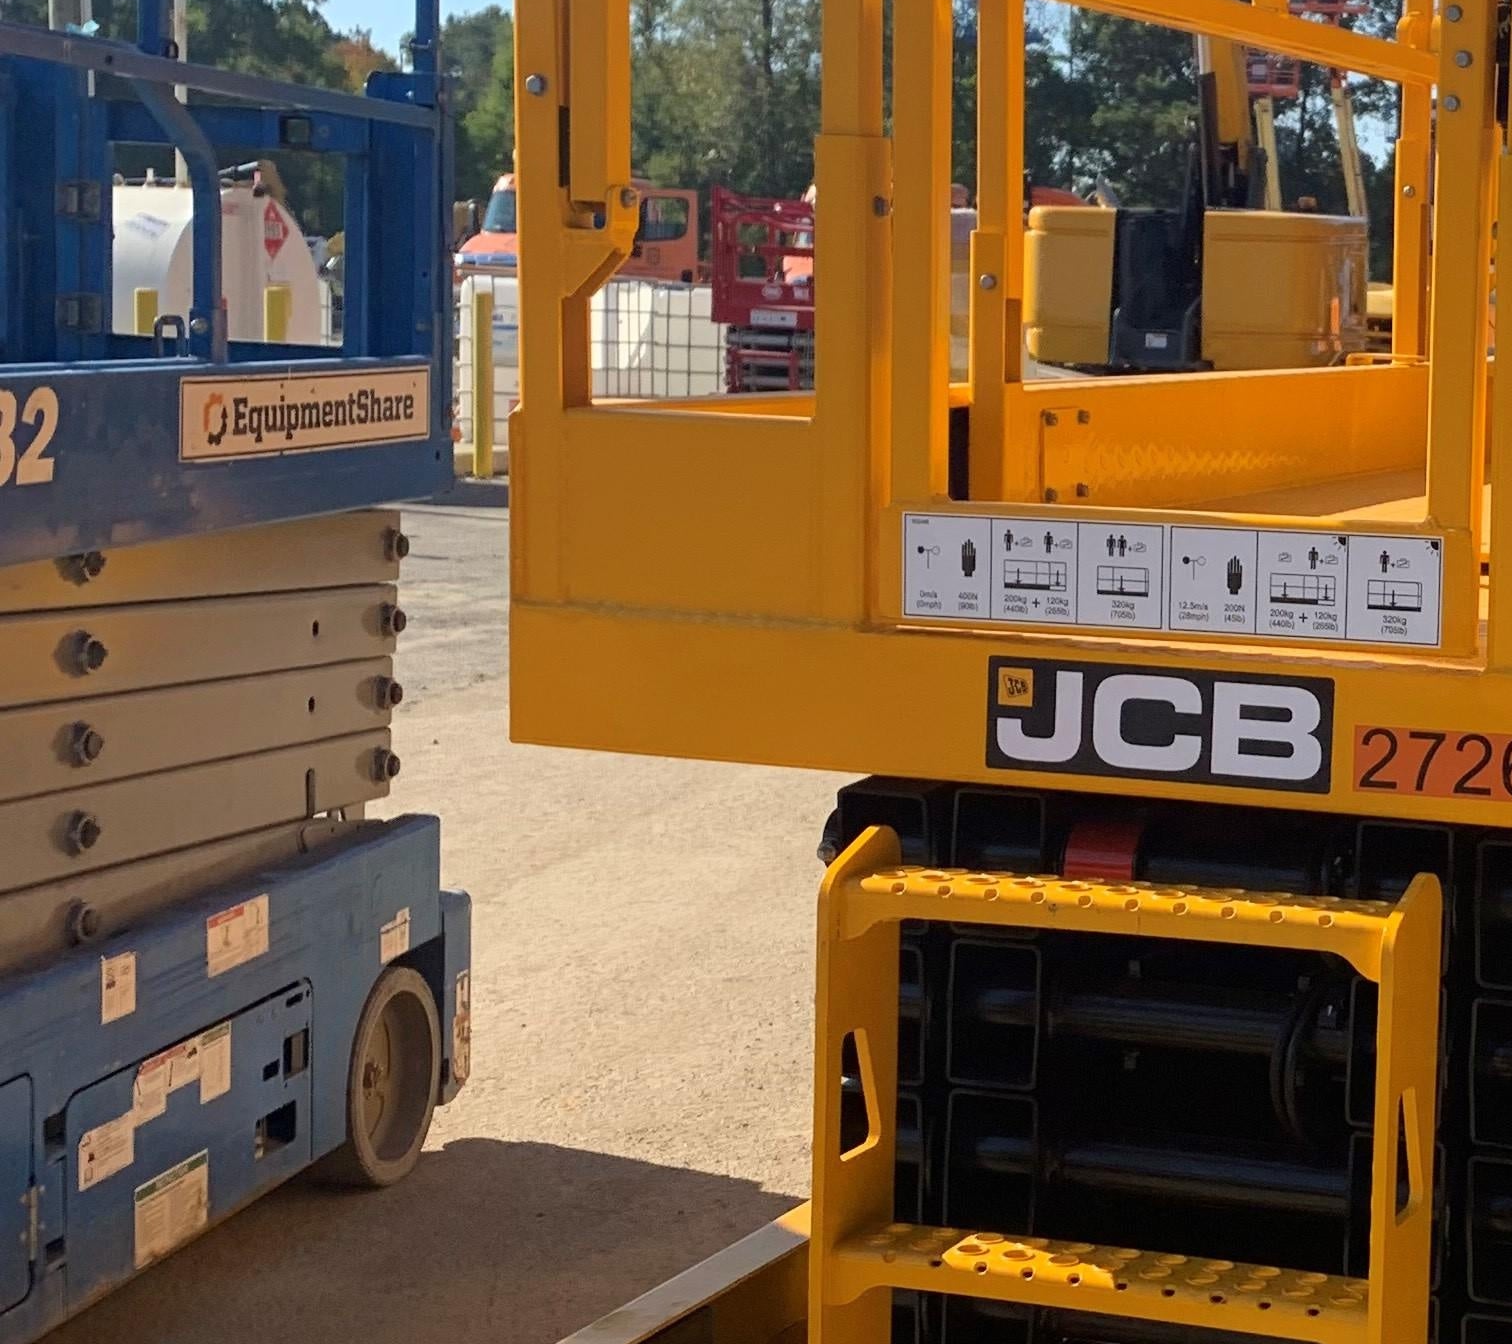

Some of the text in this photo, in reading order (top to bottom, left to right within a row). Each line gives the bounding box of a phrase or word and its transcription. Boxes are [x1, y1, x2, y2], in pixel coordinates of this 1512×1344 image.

[232, 388, 414, 443] EquipmentShare
[1004, 594, 1028, 605] 200kg
[1111, 599, 1135, 610] 320kg
[1269, 608, 1338, 622] 200kg 120kg
[1382, 614, 1407, 626] 320kg
[1006, 675, 1028, 696] JCB
[996, 670, 1322, 781] JCB
